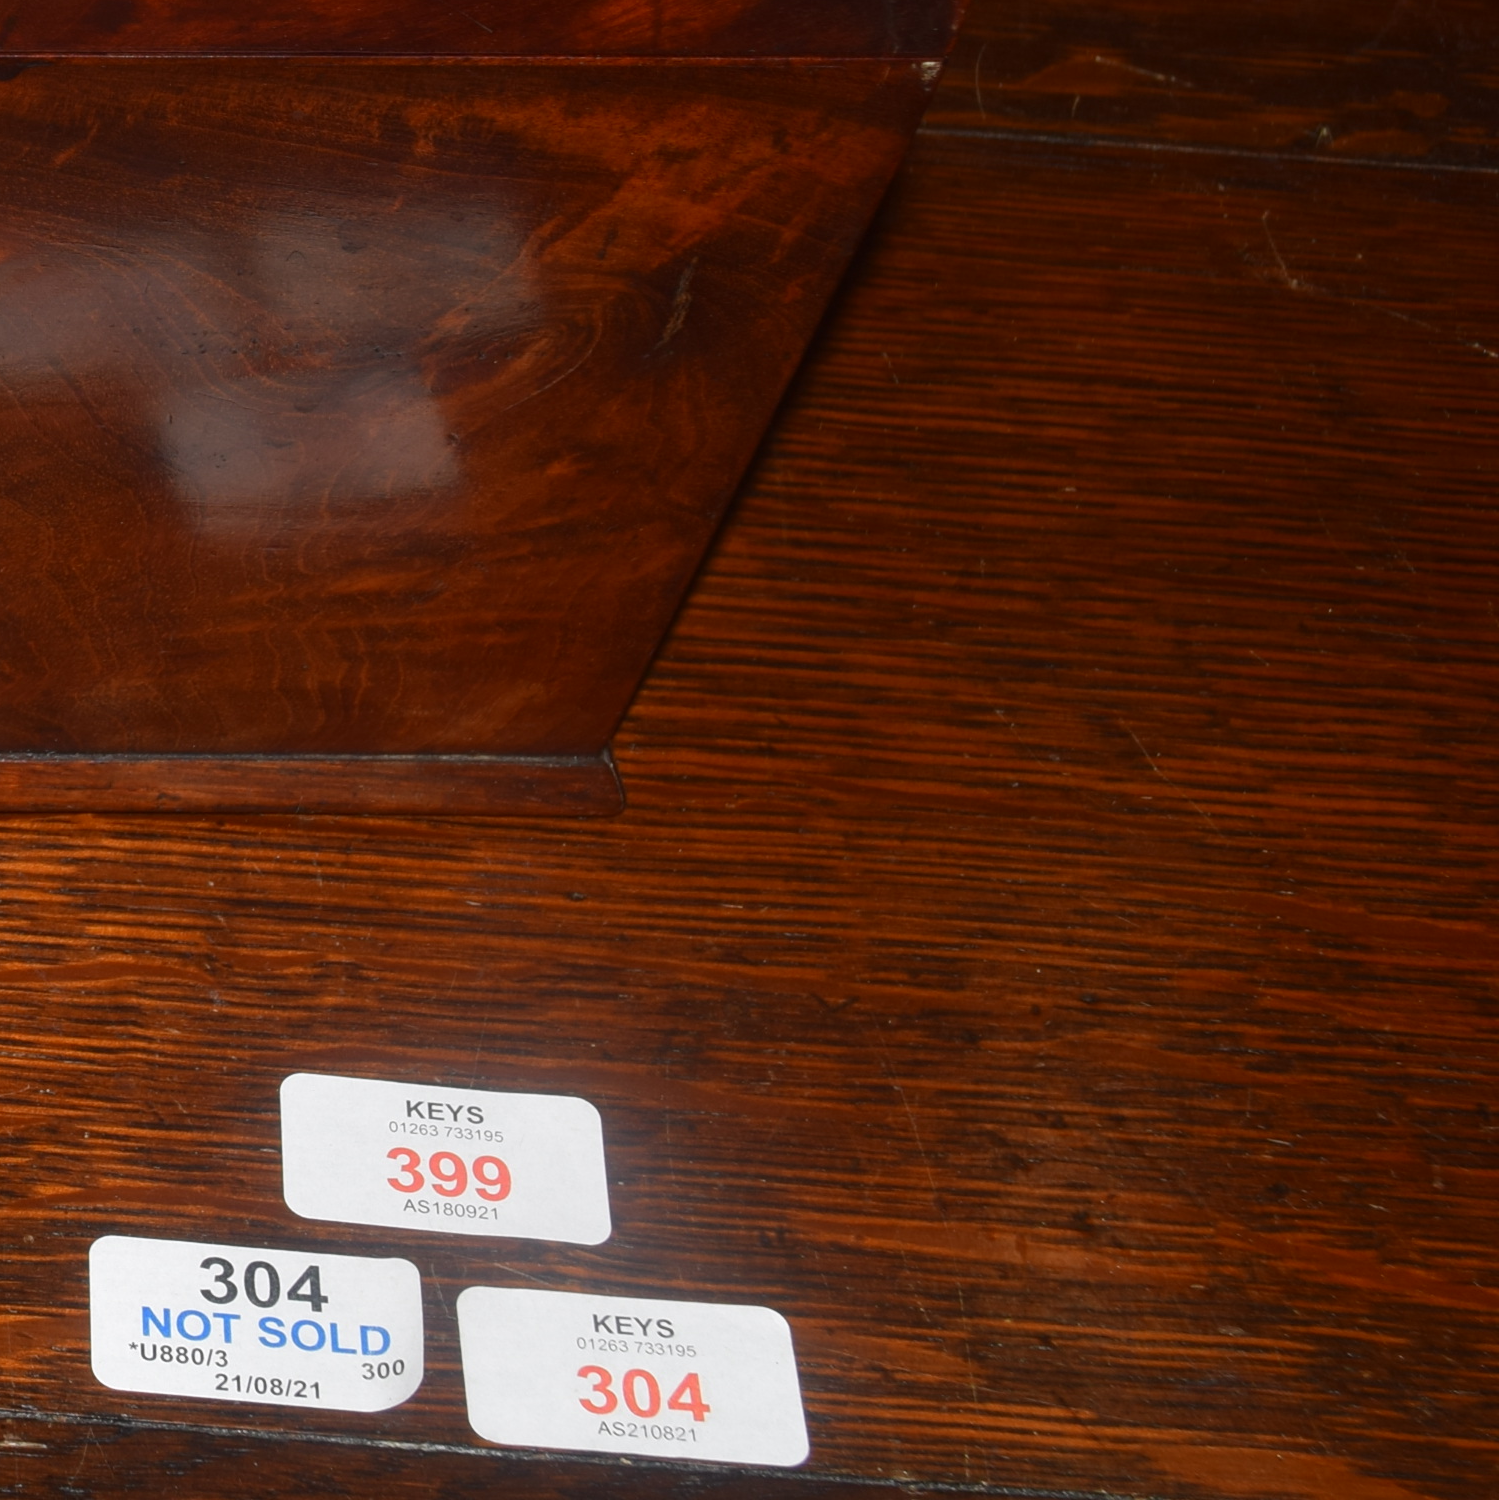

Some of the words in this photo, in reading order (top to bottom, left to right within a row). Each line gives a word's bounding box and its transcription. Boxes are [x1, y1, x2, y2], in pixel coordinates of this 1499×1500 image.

[405, 1099, 485, 1125] KEYS
[388, 1120, 441, 1138] 01263
[444, 1125, 504, 1144] 733195
[386, 1146, 512, 1202] 399
[402, 1199, 500, 1221] AS180921
[199, 1256, 329, 1313] 304
[141, 1305, 242, 1344] NOT
[257, 1316, 392, 1357] SOLD
[592, 1313, 675, 1339] KEYS
[576, 1337, 629, 1353] 01263
[634, 1341, 698, 1358] 733195
[361, 1358, 406, 1381] 300
[214, 1373, 321, 1400] 21/08/21
[576, 1365, 711, 1422] 304
[598, 1420, 698, 1443] AS210821
